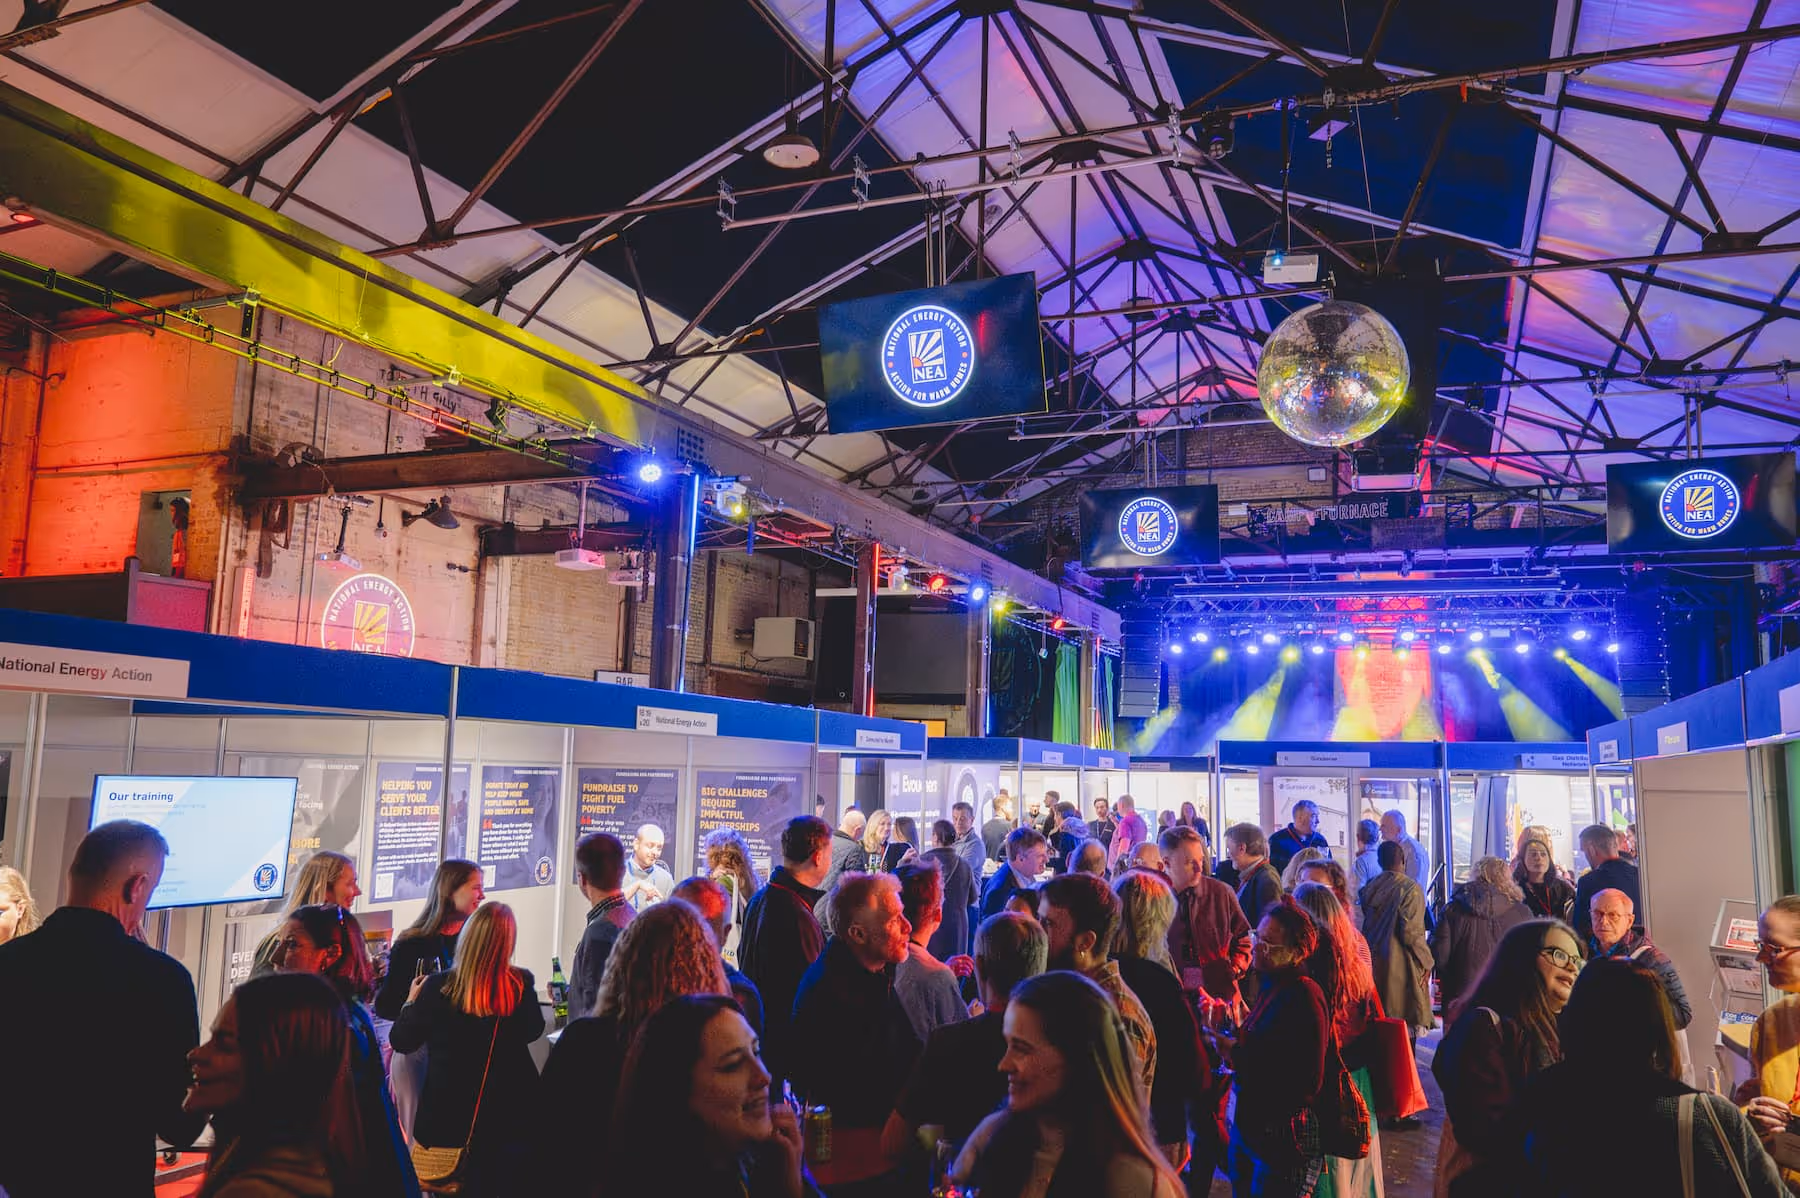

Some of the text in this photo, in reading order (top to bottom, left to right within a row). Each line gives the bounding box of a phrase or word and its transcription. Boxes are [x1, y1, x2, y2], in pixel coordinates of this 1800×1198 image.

[887, 312, 967, 356] NATIONAL ENERGY ACTION
[914, 366, 944, 380] NEA
[890, 362, 967, 400] ACTION FOR WARM HOMES
[1664, 478, 1688, 503] NATIONAL
[1717, 480, 1735, 499] ACTION
[1320, 502, 1388, 520] FURNACE
[1688, 511, 1712, 520] NEA
[329, 580, 410, 631] NATIONAL ENERGY ACTION
[60, 662, 107, 680] Energy
[112, 668, 152, 682] Action
[616, 676, 633, 686] BAR
[656, 717, 675, 725] National
[676, 718, 691, 727] Energy
[382, 780, 432, 790] HELPING YOU
[583, 784, 639, 792] FUNDRAISE TO
[109, 792, 174, 802] Our training
[701, 787, 768, 798] BIG CHALLENGES
[381, 793, 427, 803] SERVE YOUR
[582, 794, 625, 803] FIGHT FUEL
[701, 798, 736, 808] REQUIRE
[380, 806, 411, 816] CLIENTS
[582, 805, 616, 814] POVERTY
[701, 810, 744, 819] IMPACTFUL
[700, 821, 760, 832] PARTNERSHIPS
